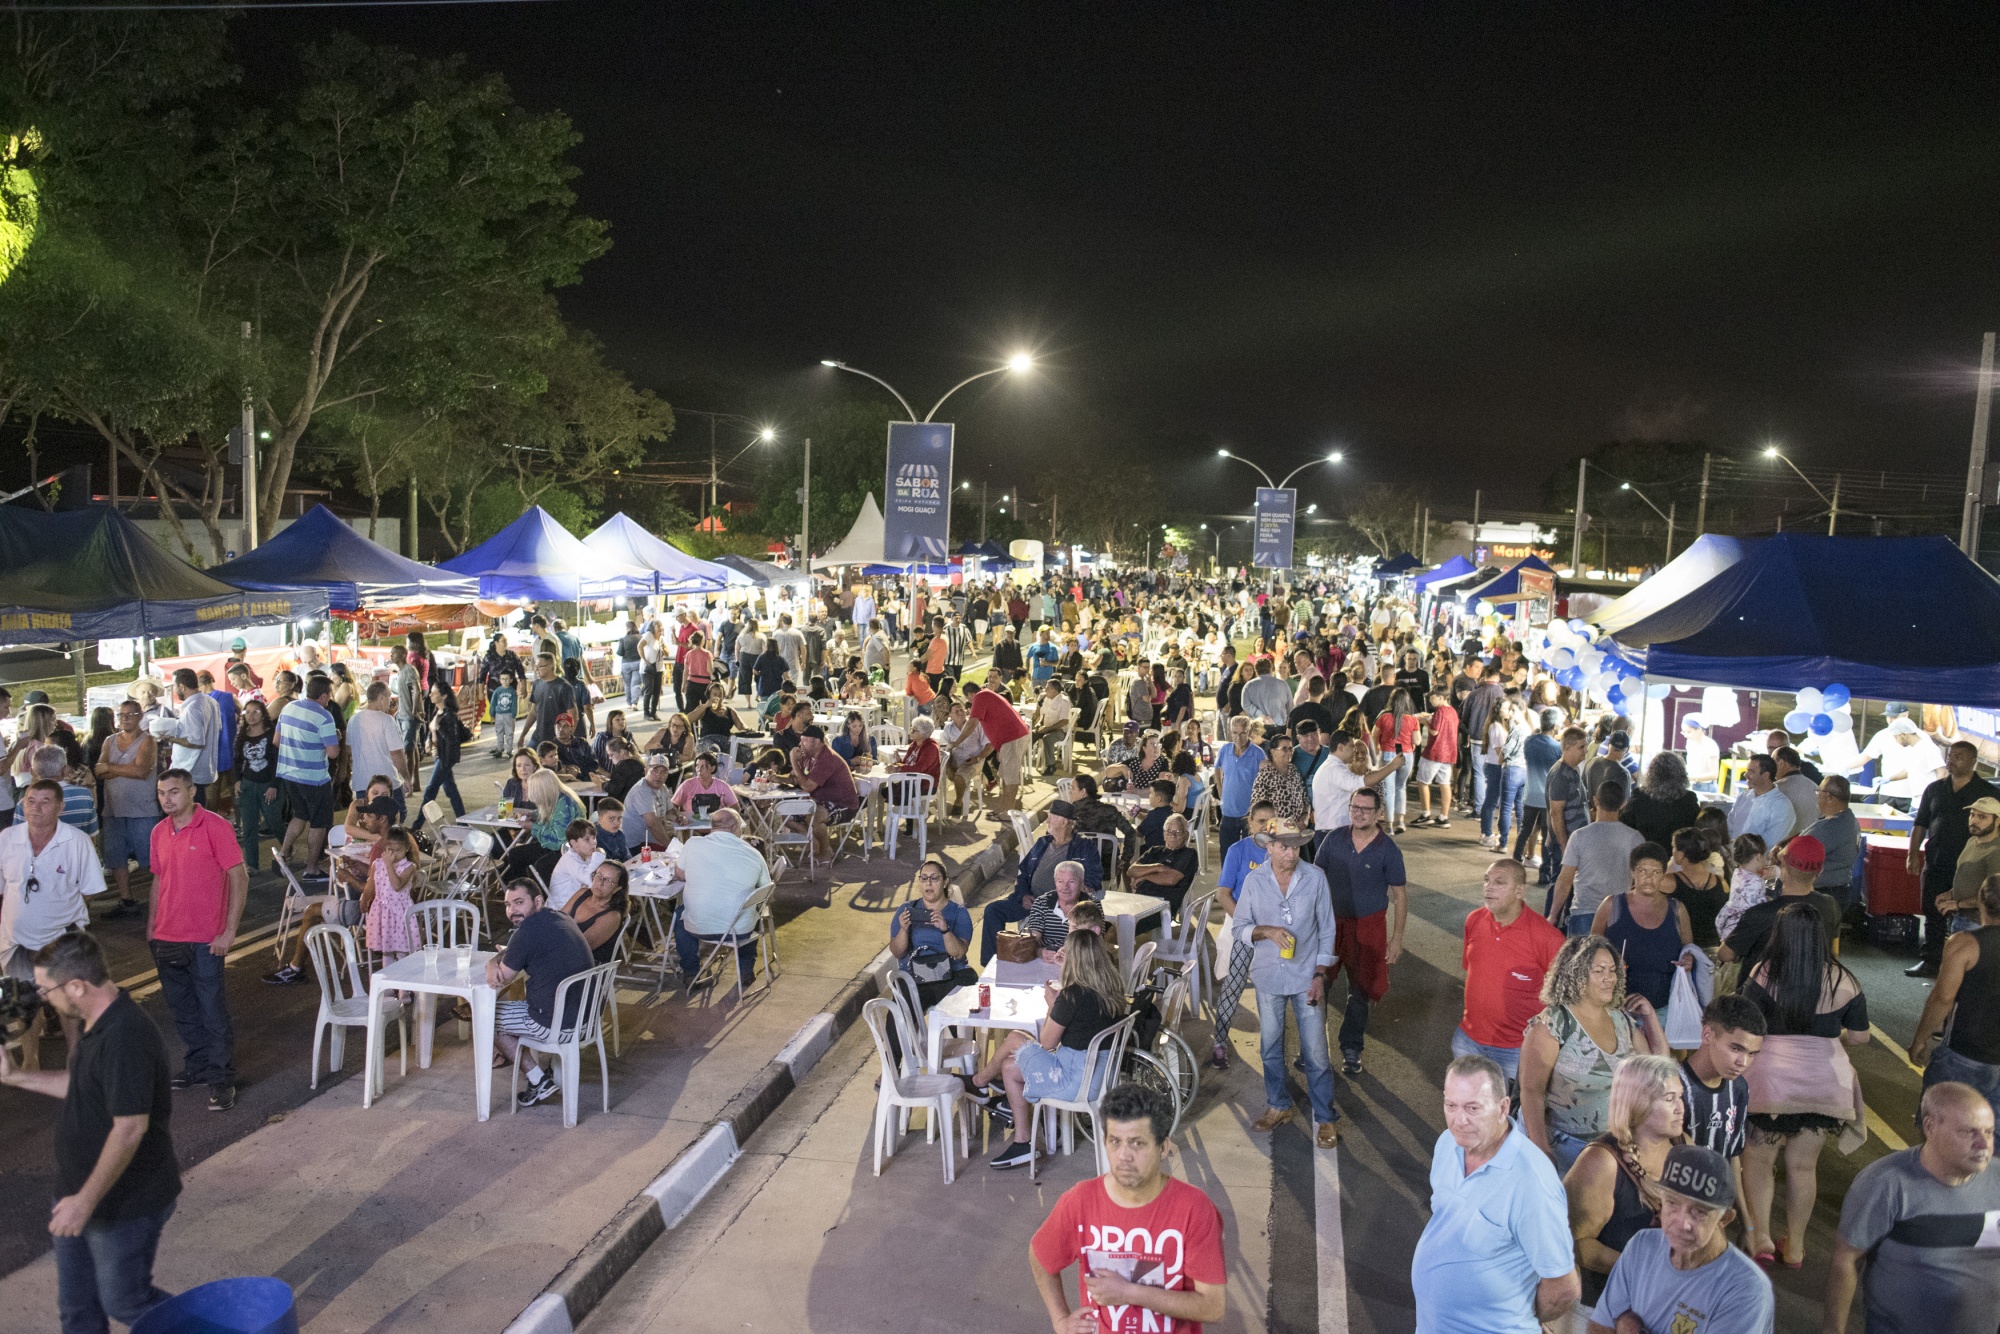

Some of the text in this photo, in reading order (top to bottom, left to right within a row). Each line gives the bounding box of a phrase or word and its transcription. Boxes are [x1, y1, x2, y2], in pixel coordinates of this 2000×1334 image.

[895, 477, 940, 489] SABOR
[911, 487, 940, 499] RUA
[1664, 1161, 1718, 1197] JESUS
[1125, 1316, 1138, 1325] 19
